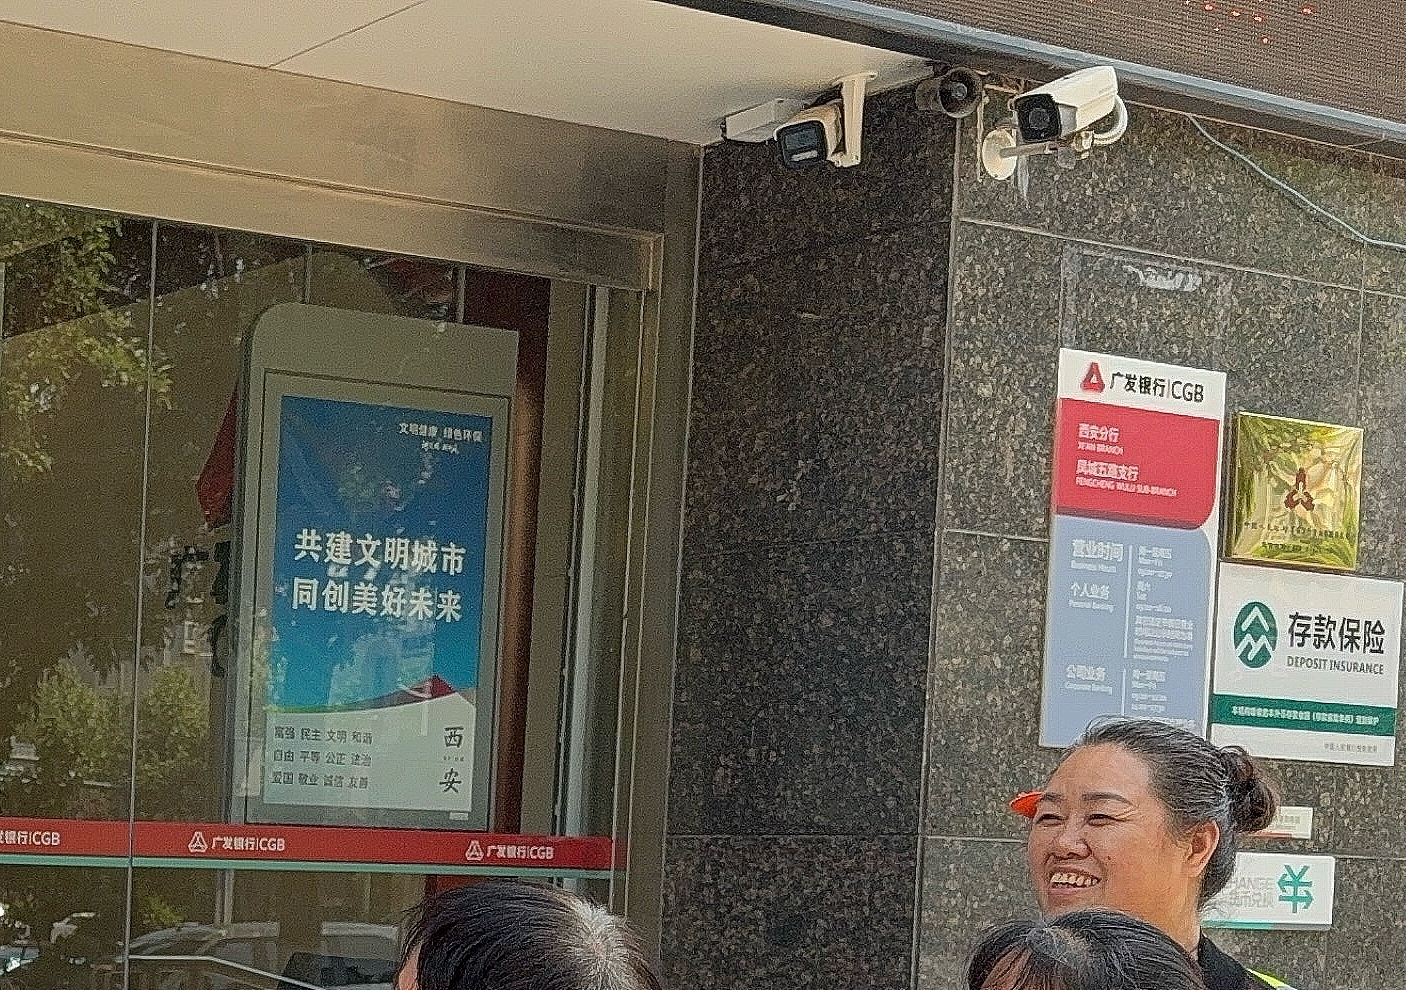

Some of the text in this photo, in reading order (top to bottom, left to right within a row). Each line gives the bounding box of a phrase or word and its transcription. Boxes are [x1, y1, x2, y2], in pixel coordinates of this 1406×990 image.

[1110, 371, 1204, 402] 广发银行 CGB
[294, 528, 466, 576] 共建文明城市
[292, 577, 462, 623] 同创美好未来
[1287, 611, 1386, 655] 存款保险
[1286, 655, 1385, 676] DEPOSIT INSURANCE
[32, 831, 61, 846] CGB
[211, 836, 285, 852] 广发银行 CGB
[529, 845, 554, 860] CGB
